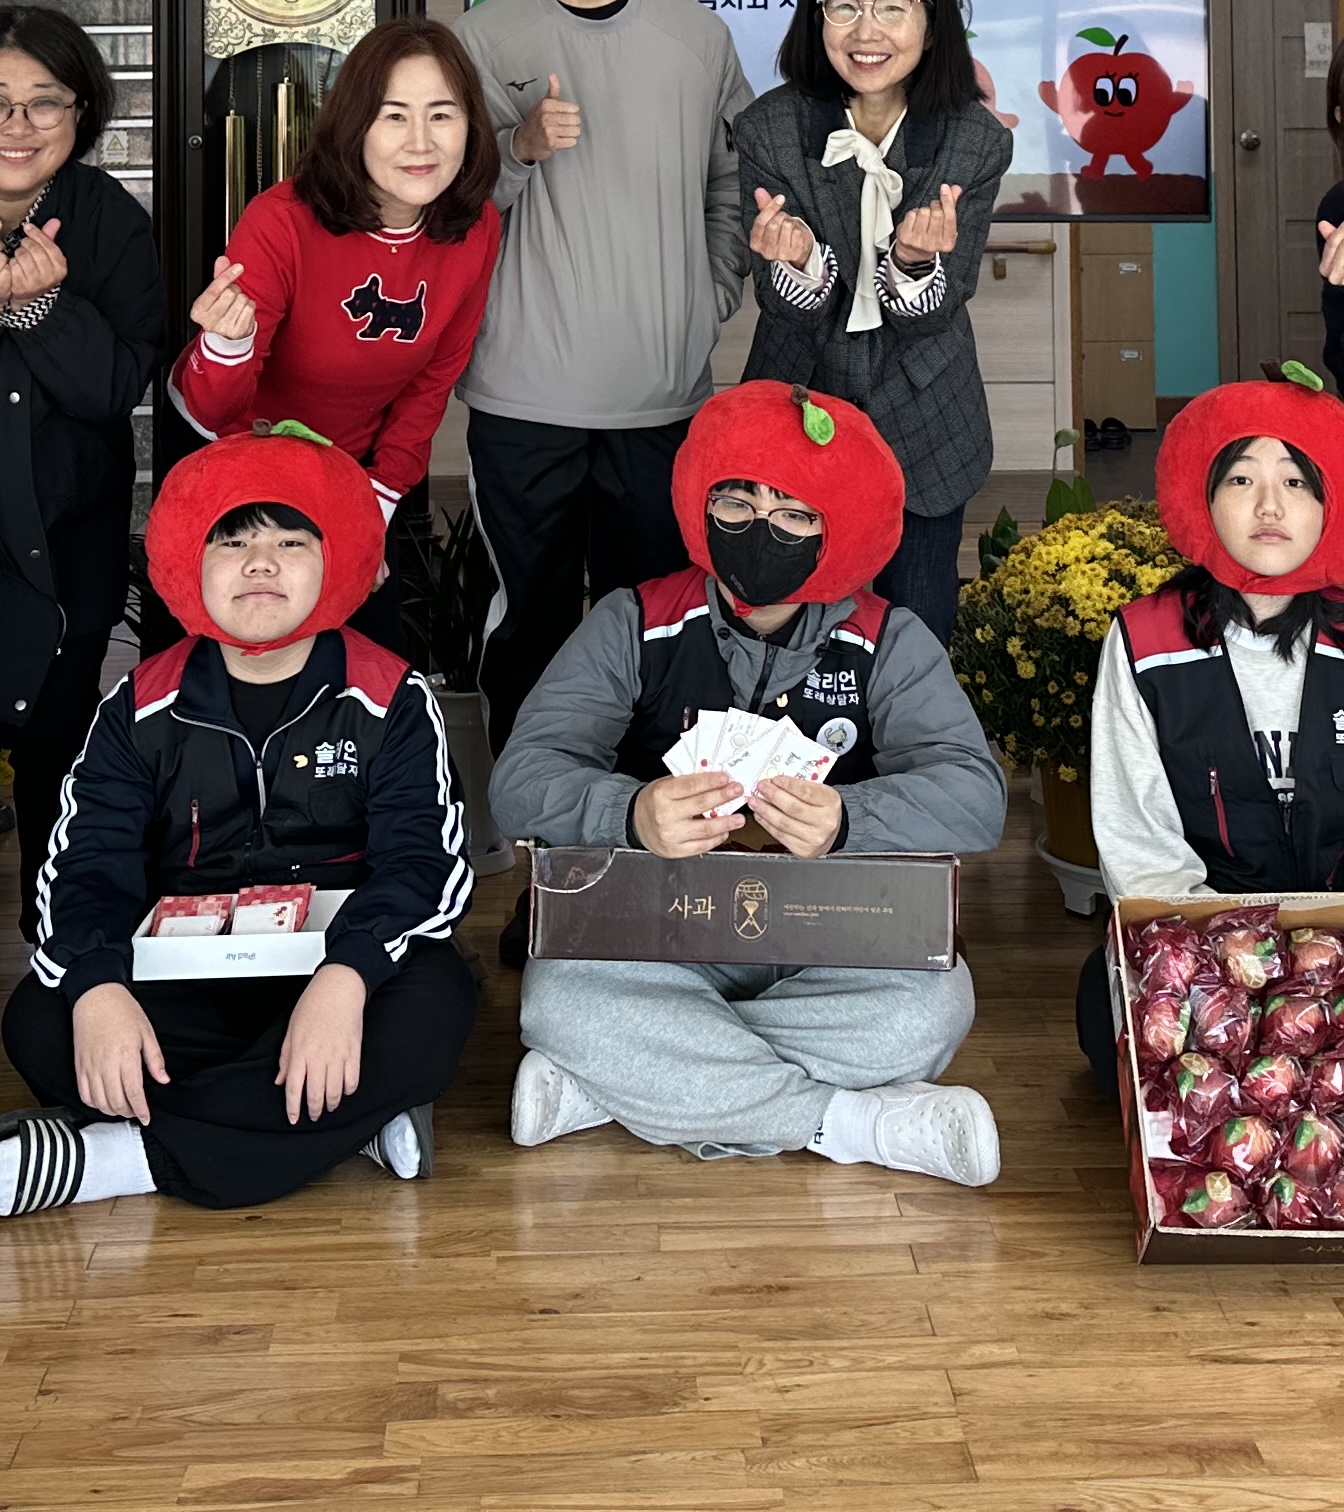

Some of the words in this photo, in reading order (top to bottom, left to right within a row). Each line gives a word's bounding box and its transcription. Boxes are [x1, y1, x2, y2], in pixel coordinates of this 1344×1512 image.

[806, 669, 858, 693] 솔리언
[803, 687, 860, 706] 또래상담자
[668, 894, 716, 920] 사과
